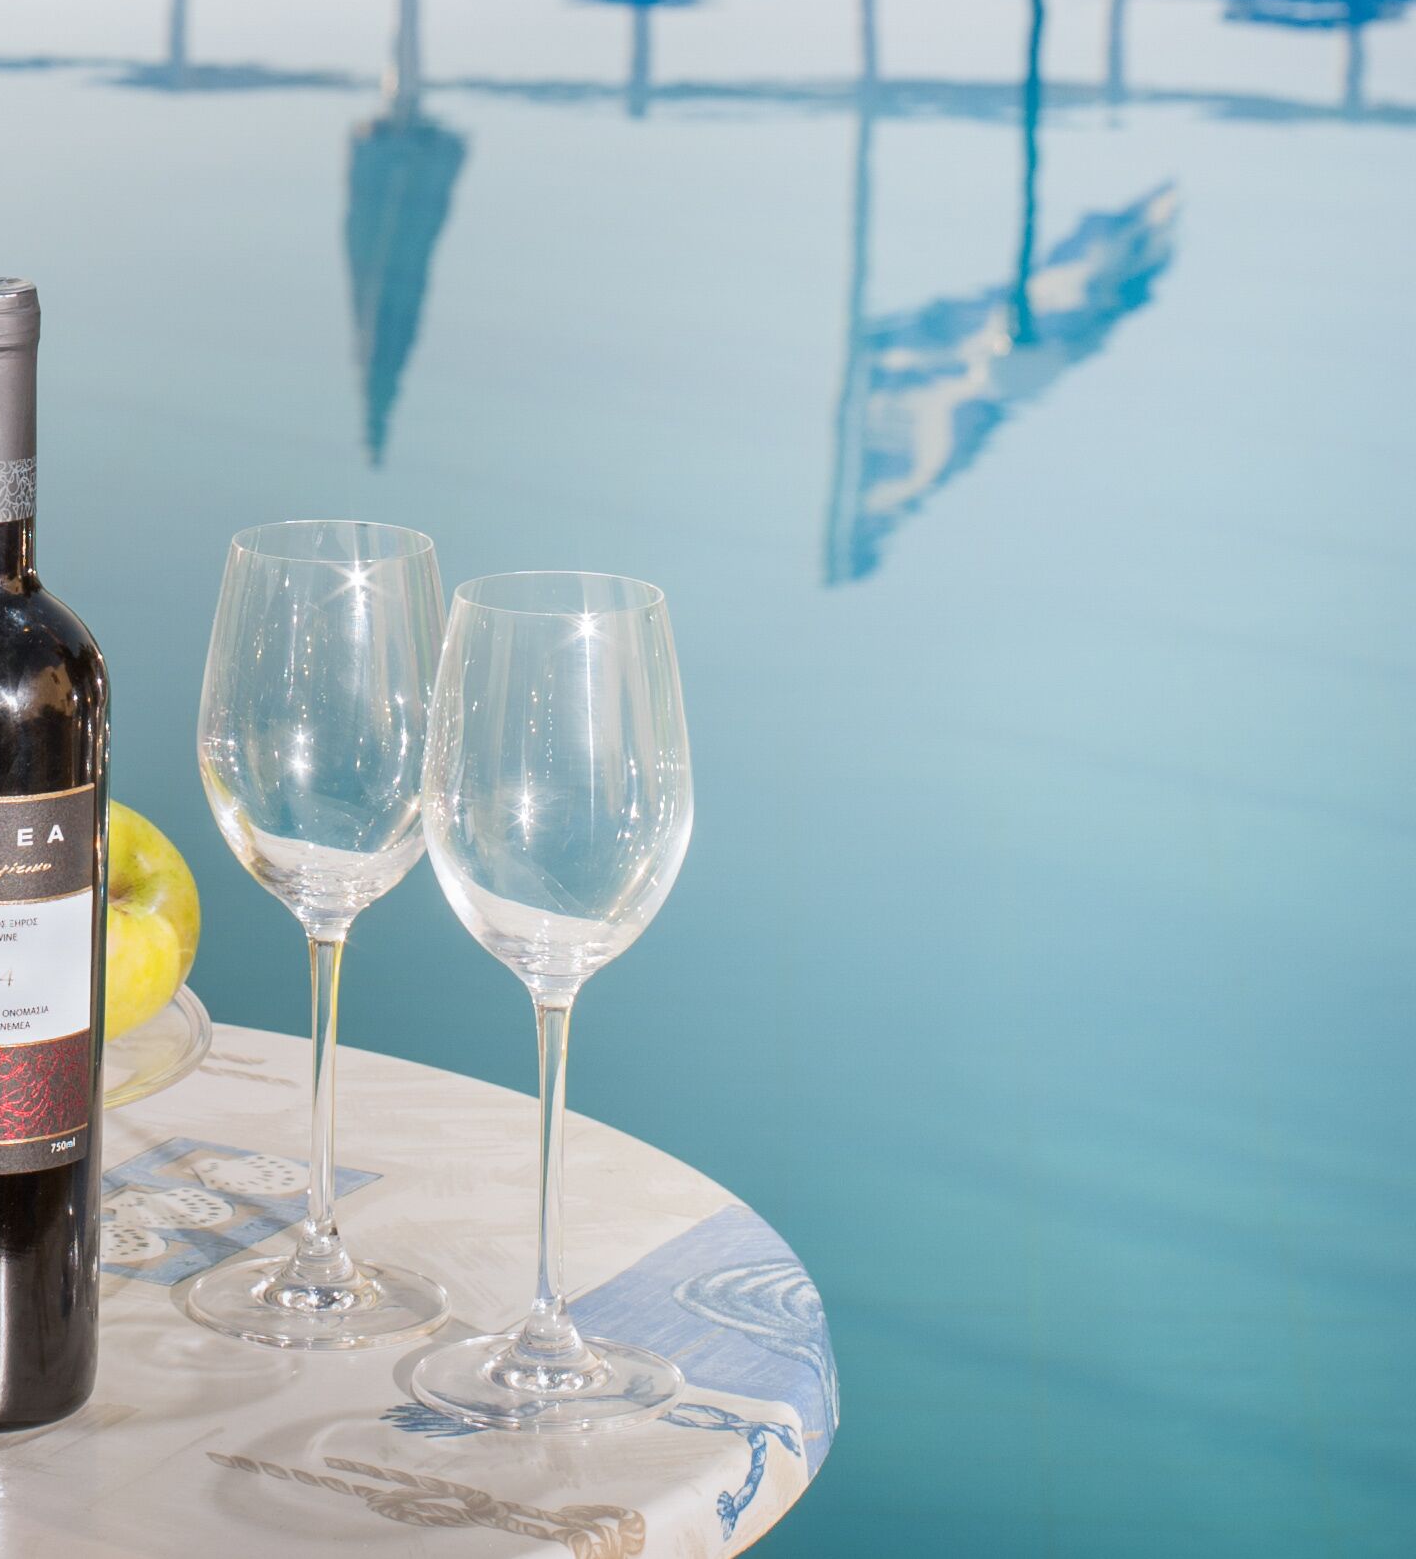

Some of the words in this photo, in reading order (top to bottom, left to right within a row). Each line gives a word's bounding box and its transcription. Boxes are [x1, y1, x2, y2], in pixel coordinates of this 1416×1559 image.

[2, 1005, 49, 1018] ΟΝΟΜΑΣΙΑ
[0, 1020, 31, 1031] ΝΕΜΕΑ
[50, 1136, 76, 1155] 750ml
